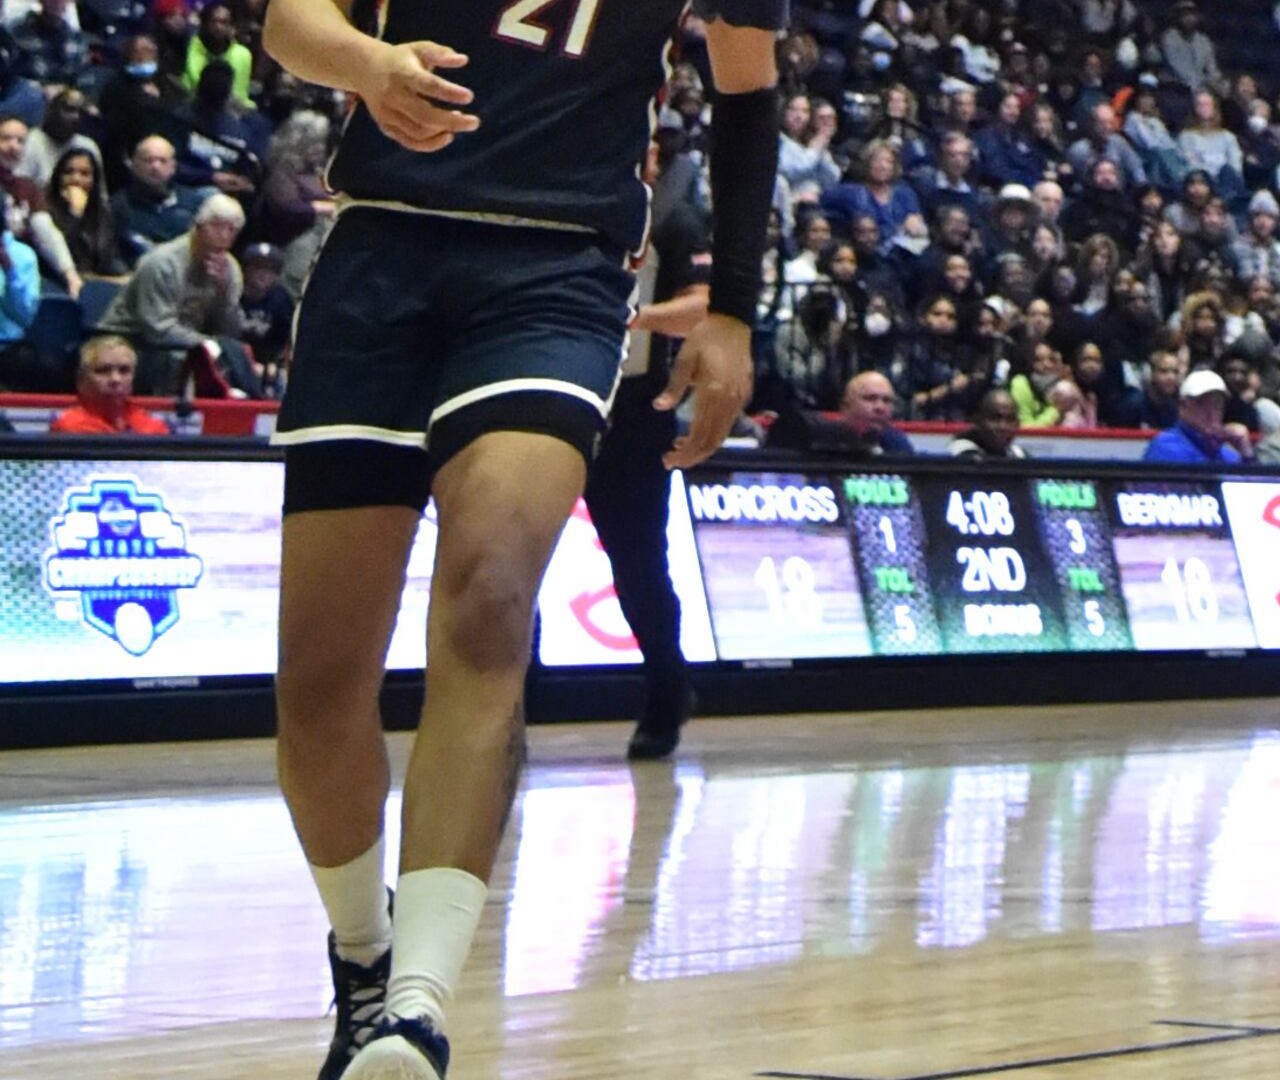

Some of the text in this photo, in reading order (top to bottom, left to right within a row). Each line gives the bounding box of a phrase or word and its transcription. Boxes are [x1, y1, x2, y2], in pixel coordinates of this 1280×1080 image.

[689, 485, 838, 521] NORCROSS
[844, 477, 909, 505] FOULS
[946, 490, 1015, 536] 4:08
[879, 516, 897, 553] 1
[1065, 519, 1087, 555] 3
[957, 547, 1027, 592] 2ND
[894, 604, 917, 644] 5
[1083, 601, 1106, 637] 5
